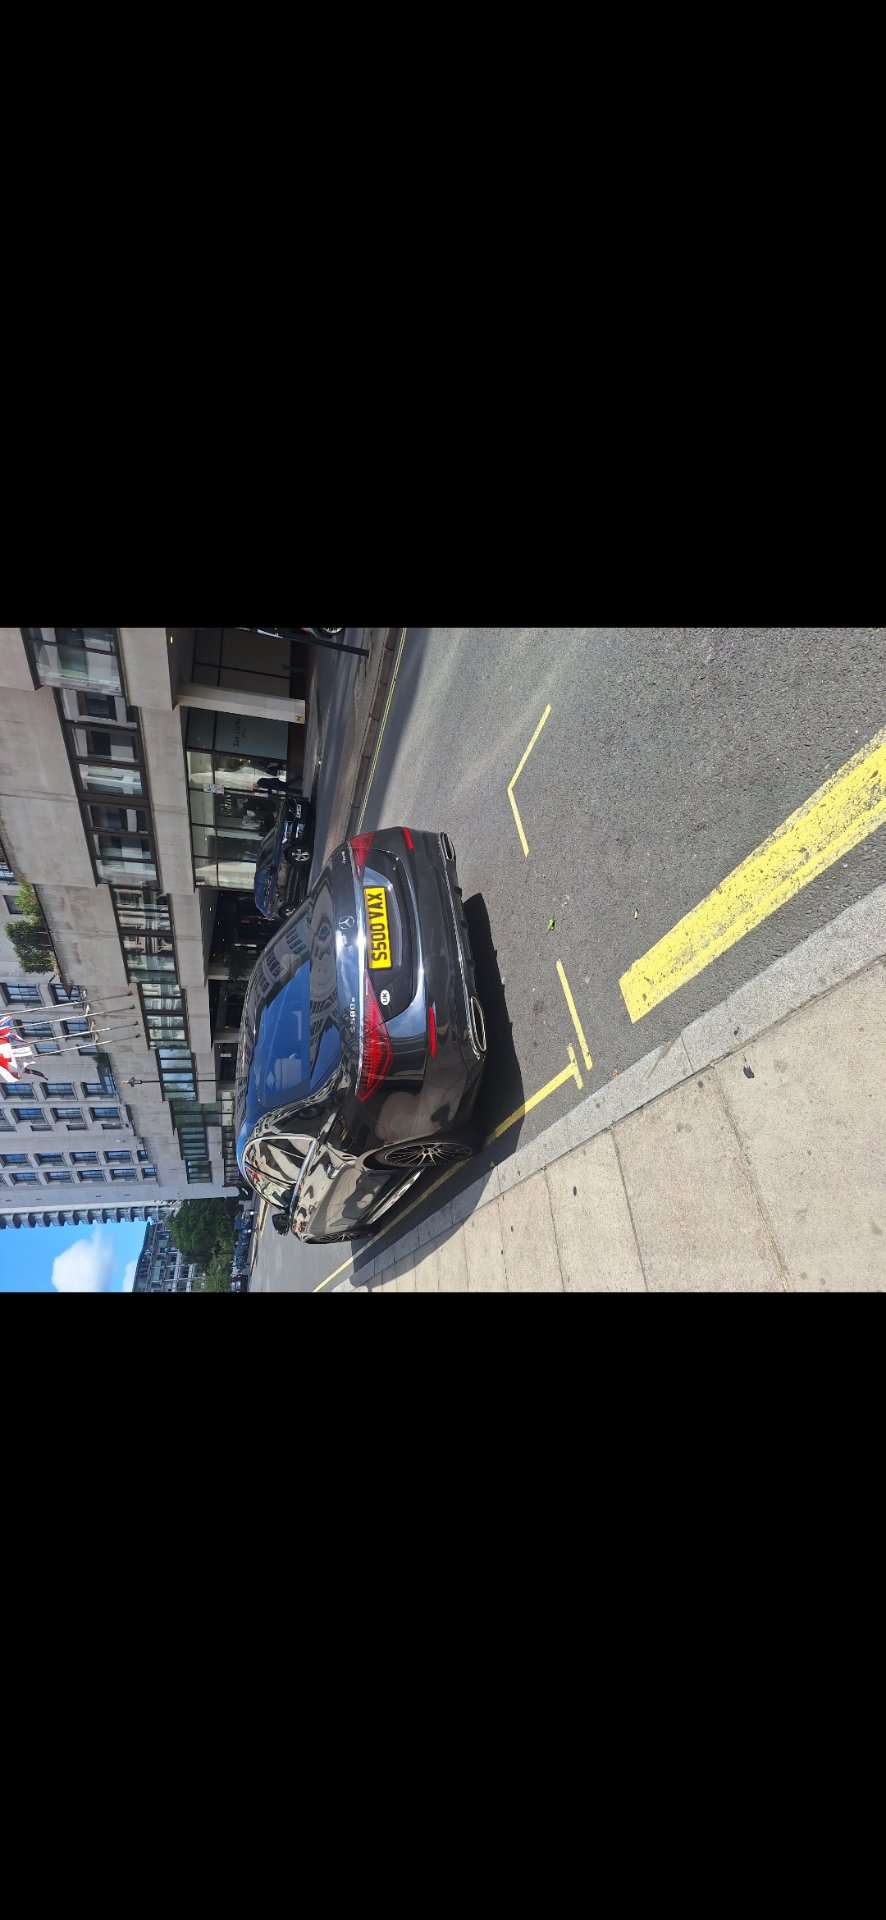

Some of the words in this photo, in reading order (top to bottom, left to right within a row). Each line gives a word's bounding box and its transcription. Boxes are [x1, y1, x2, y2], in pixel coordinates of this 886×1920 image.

[368, 892, 384, 920] VAX
[369, 923, 387, 961] S500
[382, 992, 388, 1003] UK
